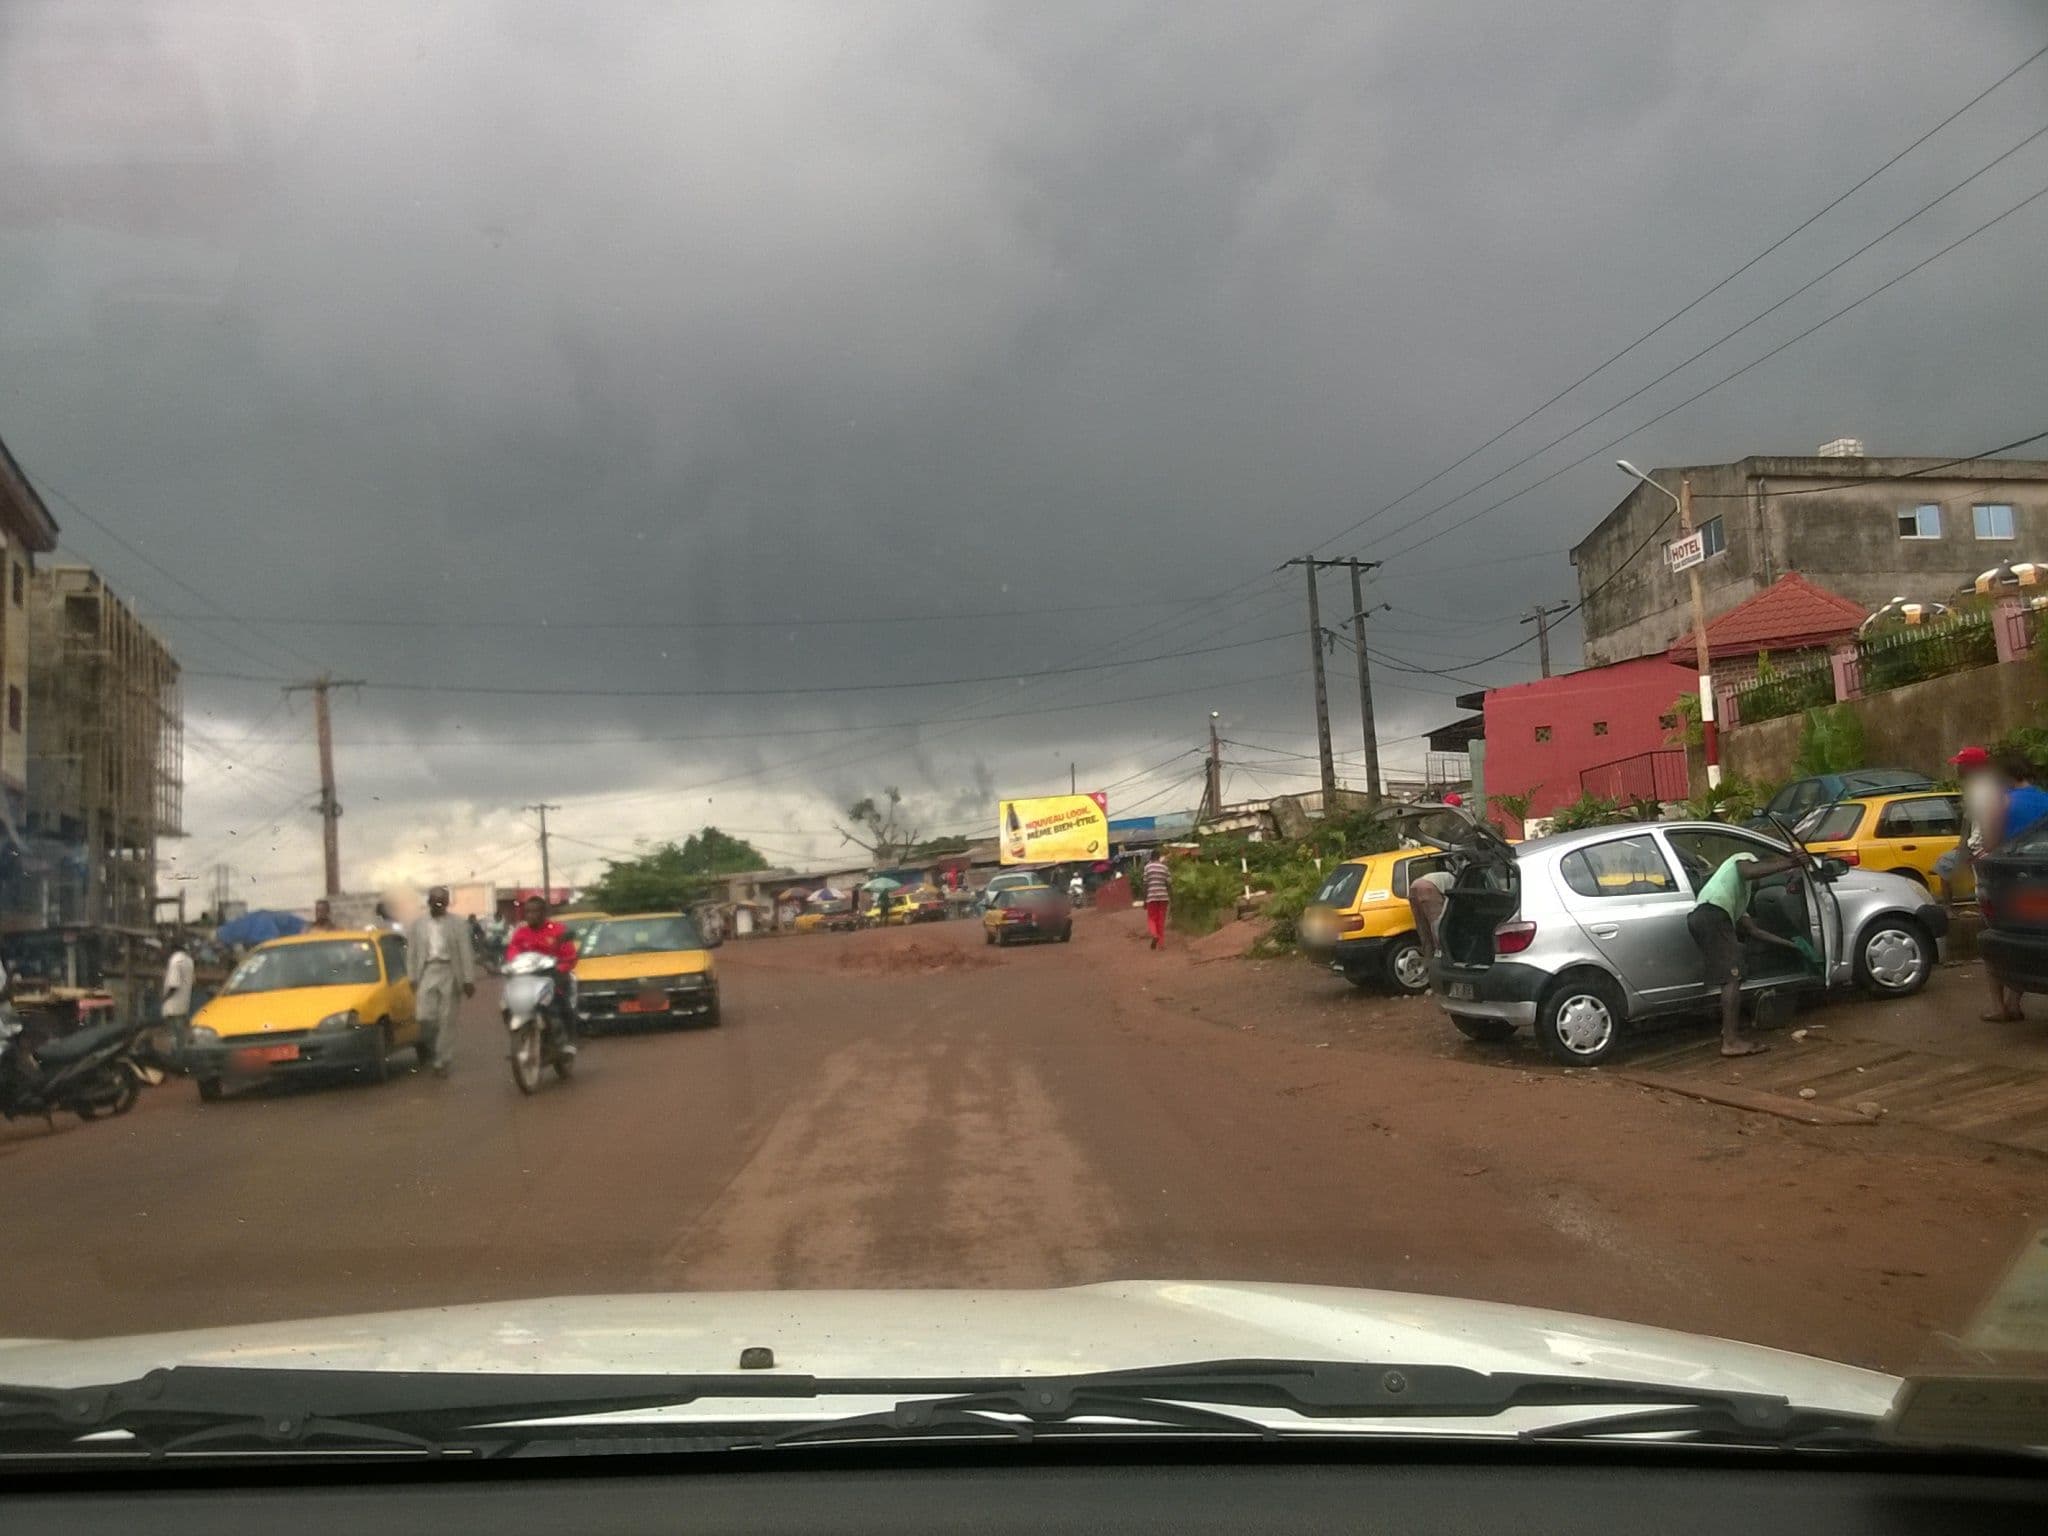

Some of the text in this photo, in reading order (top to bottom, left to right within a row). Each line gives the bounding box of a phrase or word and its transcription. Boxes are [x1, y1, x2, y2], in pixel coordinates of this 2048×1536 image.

[1672, 539, 1700, 561] HOTEL
[1025, 813, 1064, 829] NOUVEAU
[1027, 827, 1052, 840] MÊME
